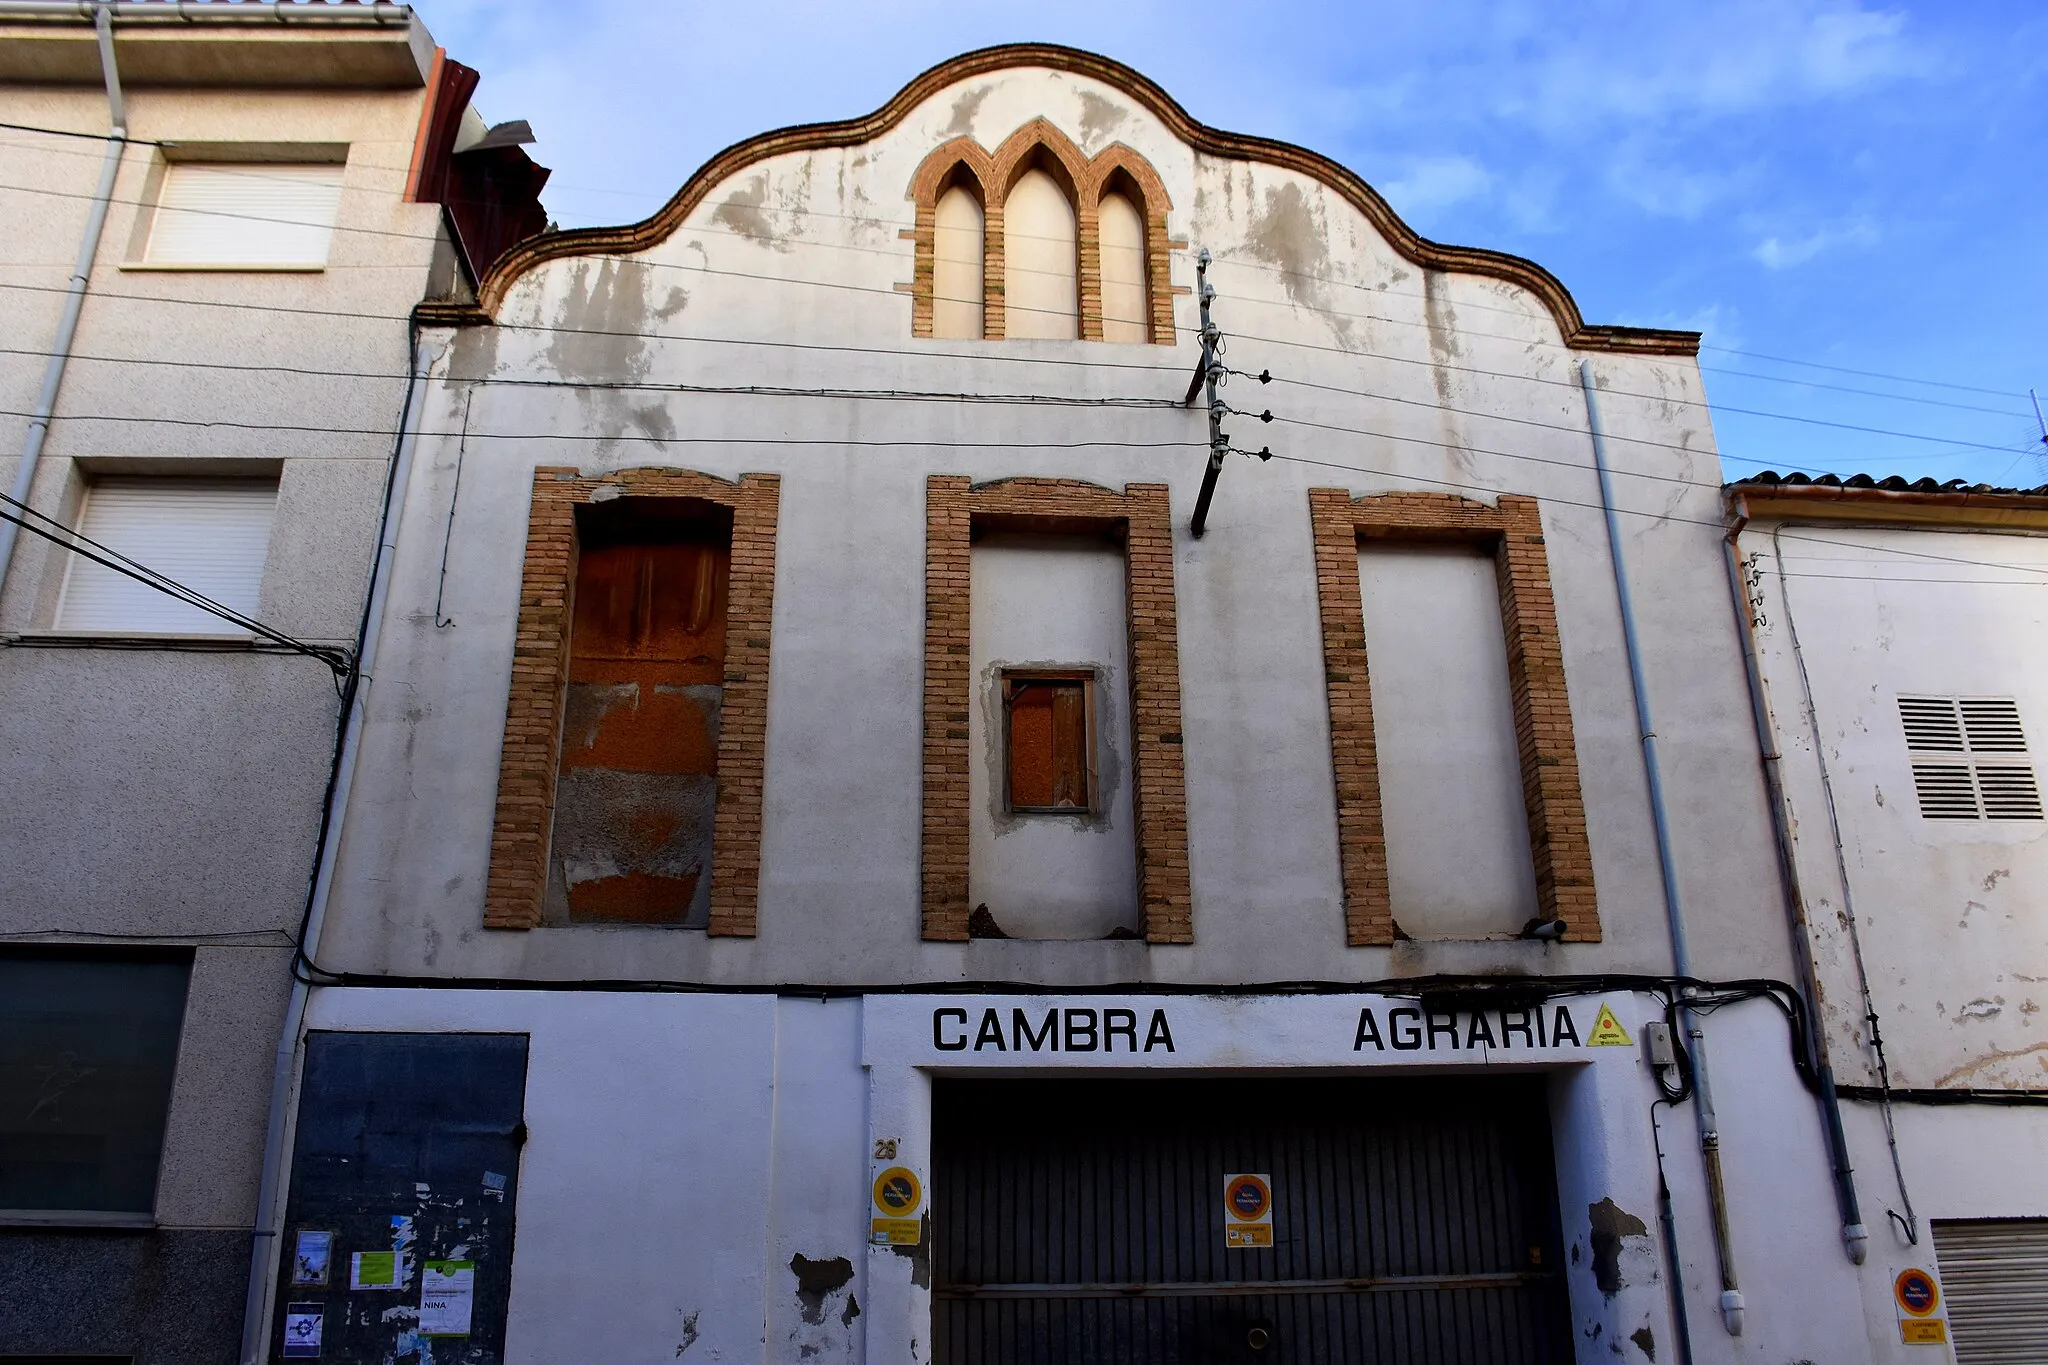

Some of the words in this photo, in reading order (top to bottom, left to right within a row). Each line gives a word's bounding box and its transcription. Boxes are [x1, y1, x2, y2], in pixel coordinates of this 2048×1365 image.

[933, 1008, 1176, 1052] CAMBRA
[1353, 1005, 1581, 1051] AGRARIA
[875, 1139, 896, 1159] 28
